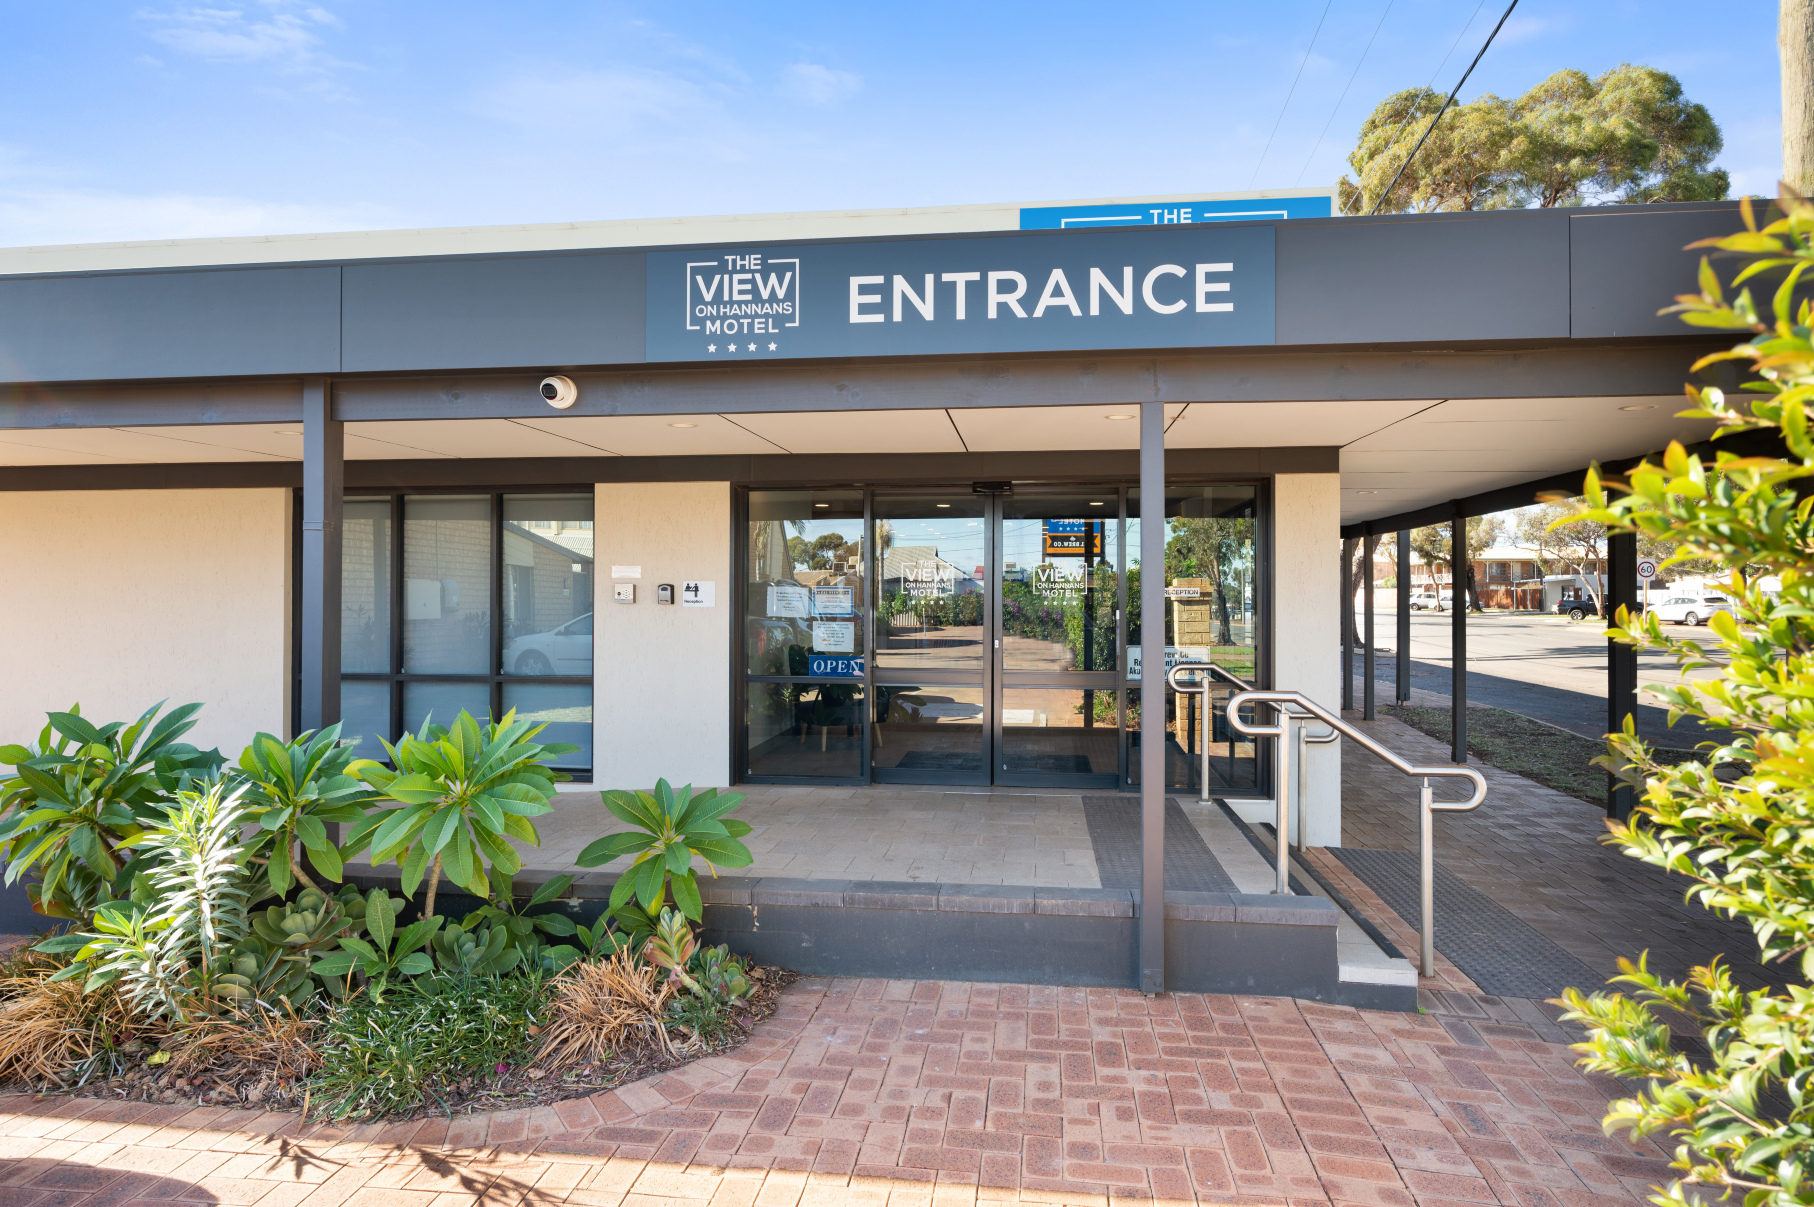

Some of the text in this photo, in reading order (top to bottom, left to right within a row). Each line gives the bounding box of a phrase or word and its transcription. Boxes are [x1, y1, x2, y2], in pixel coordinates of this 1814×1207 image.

[1149, 208, 1192, 225] THE
[724, 254, 762, 270] THE
[695, 271, 793, 302] VIEW
[849, 262, 1234, 324] ENTRANCE
[695, 302, 793, 317] ON HANNANS
[706, 318, 779, 335] MOTEL
[920, 560, 937, 568] THE
[905, 568, 951, 582] VIEW
[1037, 568, 1084, 582] VIEW
[910, 589, 944, 597] MOTEL
[1042, 589, 1078, 597] MOTEL
[813, 660, 861, 674] OPEN
